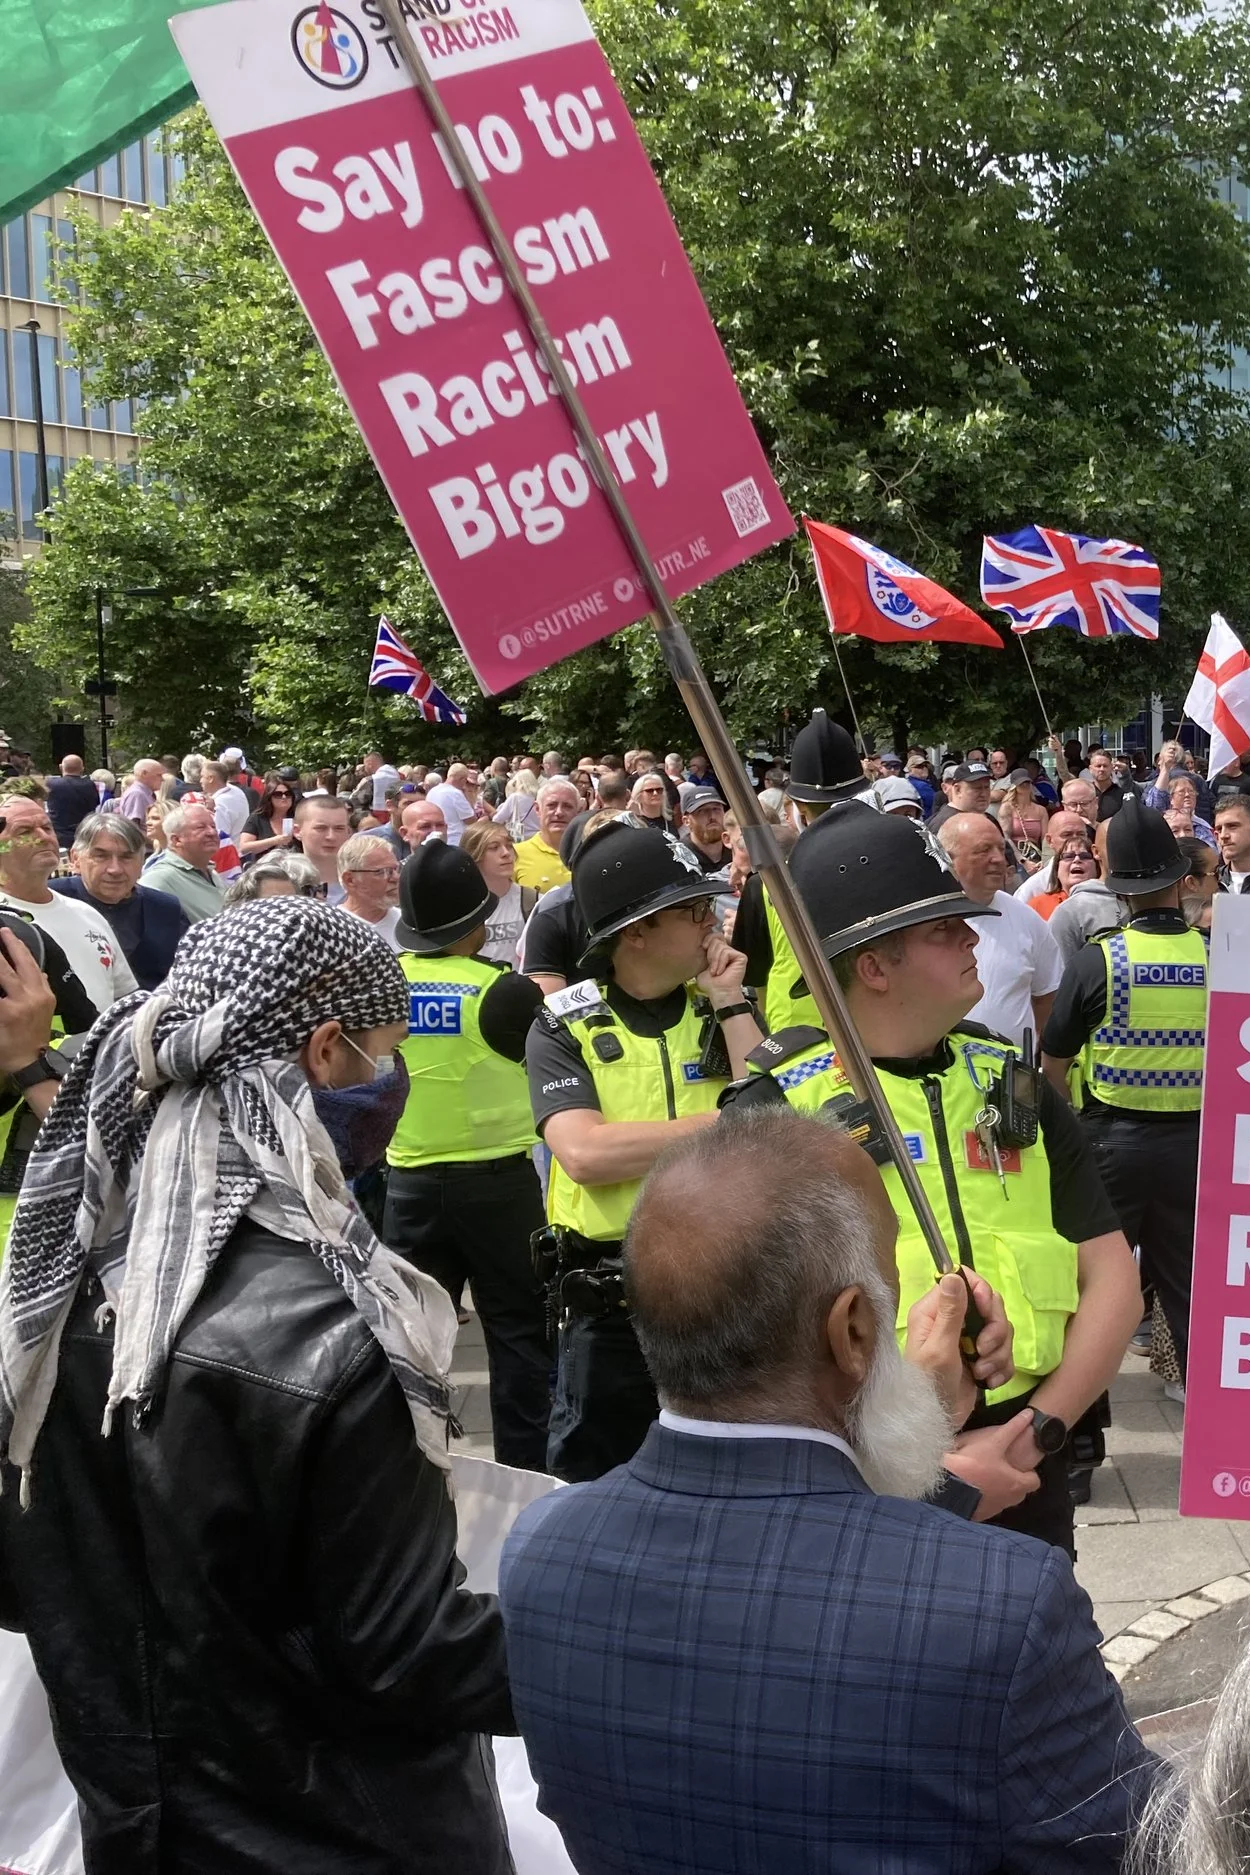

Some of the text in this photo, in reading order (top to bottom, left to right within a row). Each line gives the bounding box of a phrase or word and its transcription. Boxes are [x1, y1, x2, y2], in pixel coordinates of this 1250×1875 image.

[419, 7, 520, 59] RACISM
[273, 84, 617, 233] Say no to:
[325, 205, 611, 350] Fascsm
[520, 536, 712, 648] @SUTRNE @UTR_NE
[1136, 965, 1204, 984] POLICE
[761, 1038, 784, 1055] 8020
[542, 1077, 580, 1094] POLICE
